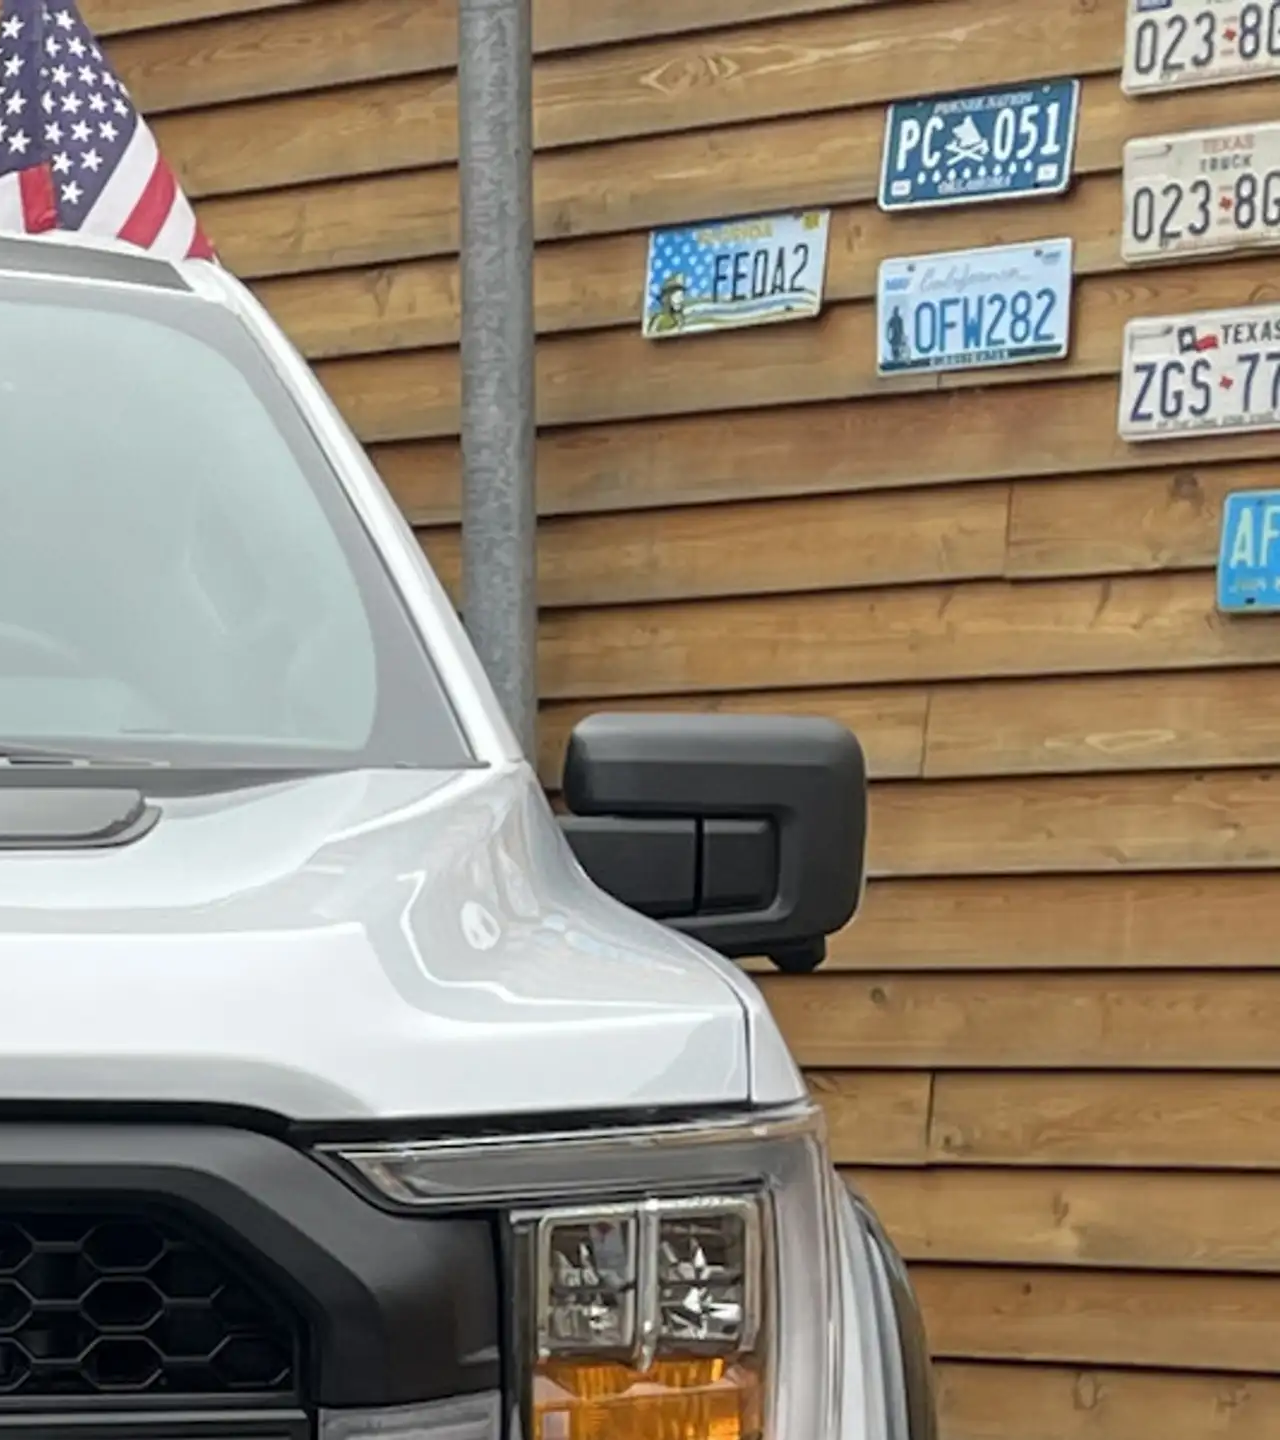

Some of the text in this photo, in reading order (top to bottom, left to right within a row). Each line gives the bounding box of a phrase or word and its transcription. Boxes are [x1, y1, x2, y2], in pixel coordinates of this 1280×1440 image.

[1134, 9, 1216, 75] 023
[895, 102, 1061, 172] PC 051
[1133, 180, 1211, 243] 023
[1130, 358, 1211, 422] ZGS
